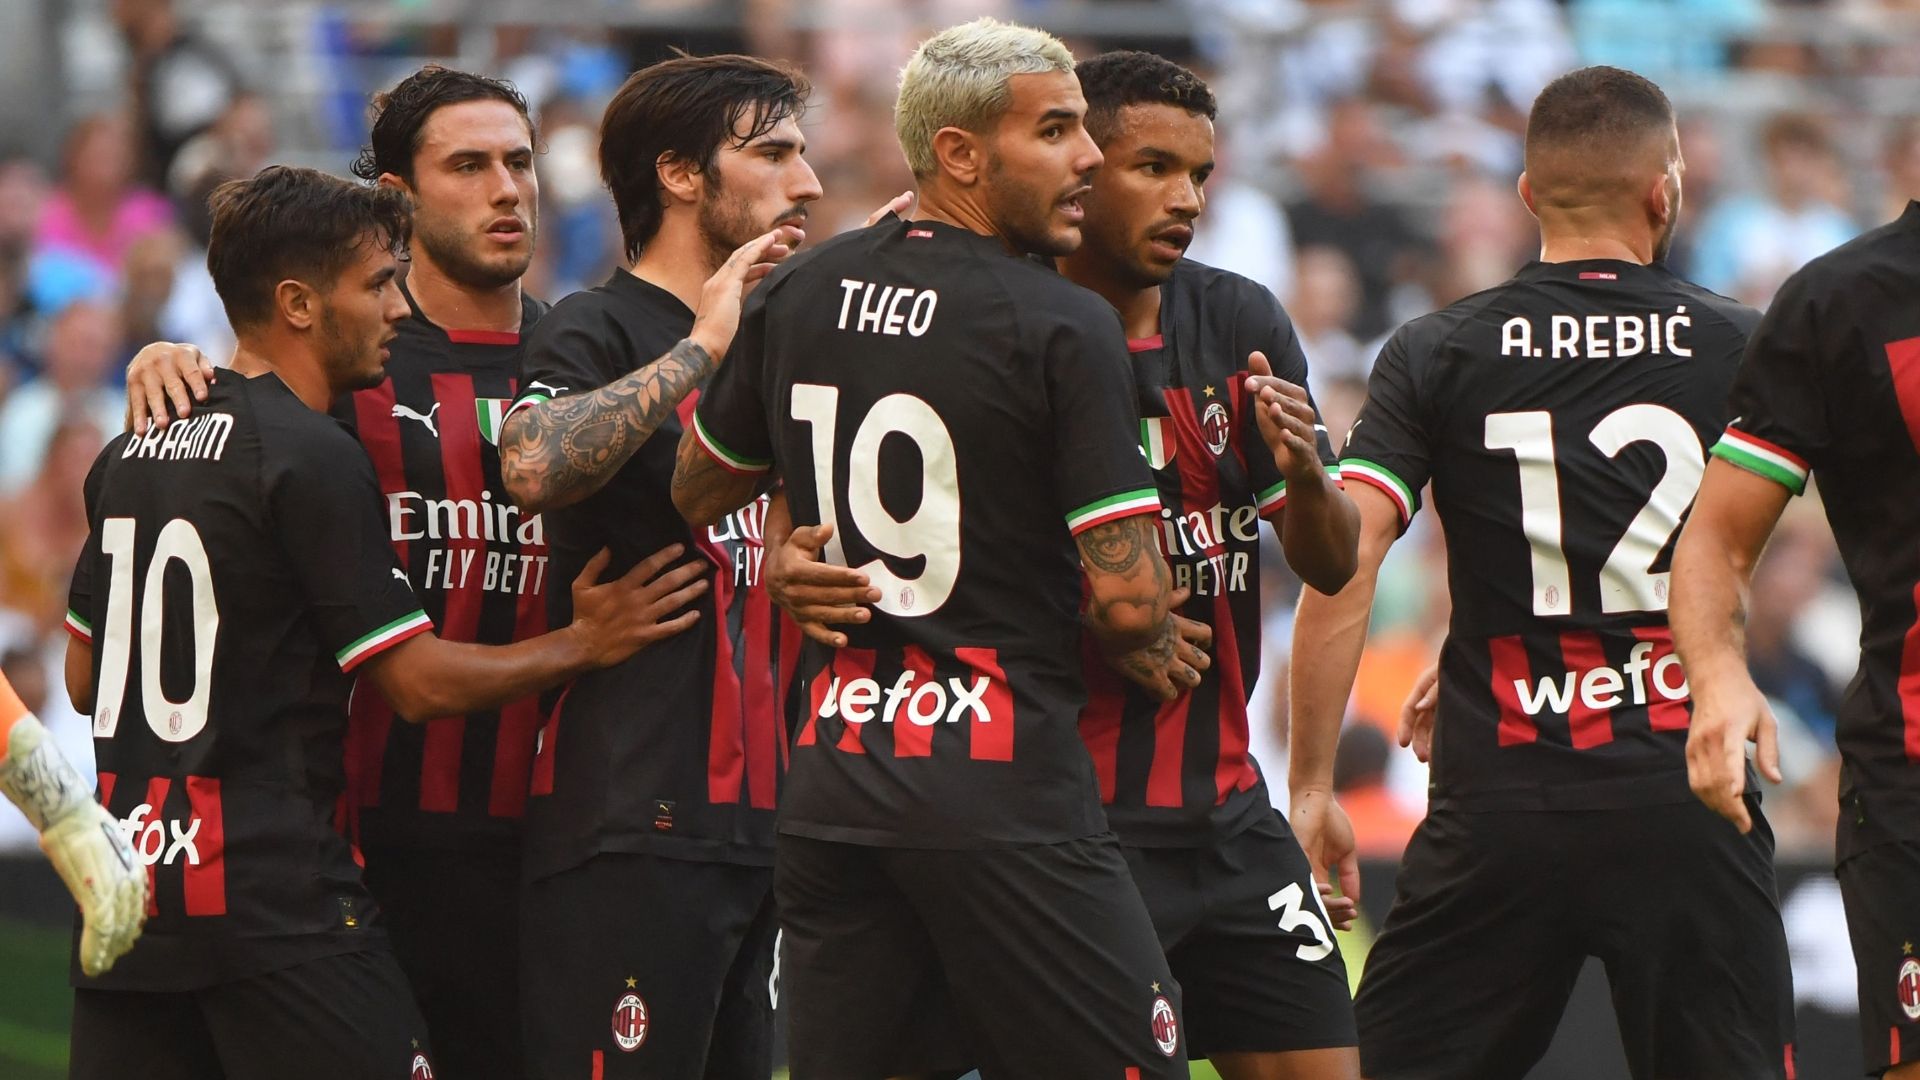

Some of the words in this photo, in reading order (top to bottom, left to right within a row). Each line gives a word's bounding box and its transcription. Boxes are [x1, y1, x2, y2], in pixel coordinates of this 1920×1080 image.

[838, 279, 938, 337] THEO
[1501, 306, 1692, 359] A.REBIĆ
[121, 412, 235, 461] BRAHIM
[385, 490, 546, 546] Emira
[790, 383, 962, 617] 19
[1153, 501, 1259, 556] irate
[1484, 403, 1706, 617] 12
[424, 549, 476, 590] FLY
[482, 551, 549, 596] BETT
[734, 547, 765, 587] FLY
[93, 517, 220, 743] 10
[1513, 641, 1691, 716] wefo
[120, 803, 202, 866] fox
[1267, 872, 1337, 962] 3
[621, 996, 641, 1008] ACM
